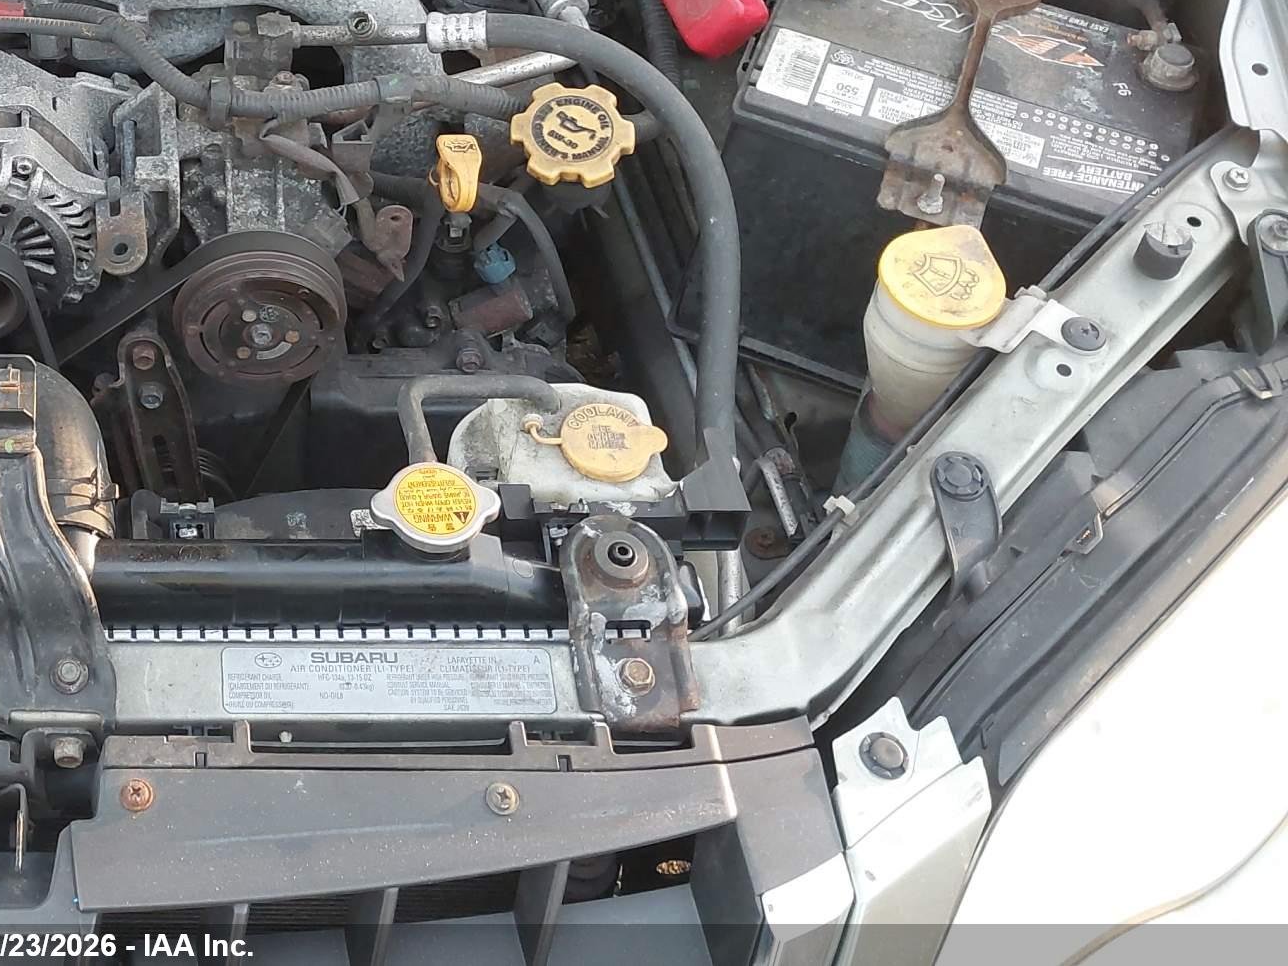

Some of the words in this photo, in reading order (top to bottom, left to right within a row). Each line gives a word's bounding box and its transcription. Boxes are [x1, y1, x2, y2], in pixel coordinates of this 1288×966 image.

[836, 82, 860, 96] 550
[1112, 82, 1132, 96] F6
[555, 98, 601, 114] ENGINE
[597, 113, 610, 130] OIL
[547, 129, 579, 149] 5W-30
[571, 136, 610, 160] MANUAL
[1077, 164, 1133, 181] BATTERY
[1042, 166, 1161, 196] INTENANCE-FREE
[568, 405, 640, 430] COOLANT
[413, 513, 454, 524] WARNING
[310, 652, 398, 664] SUBARU
[533, 656, 541, 664] A
[308, 665, 372, 673] CONDITIONER
